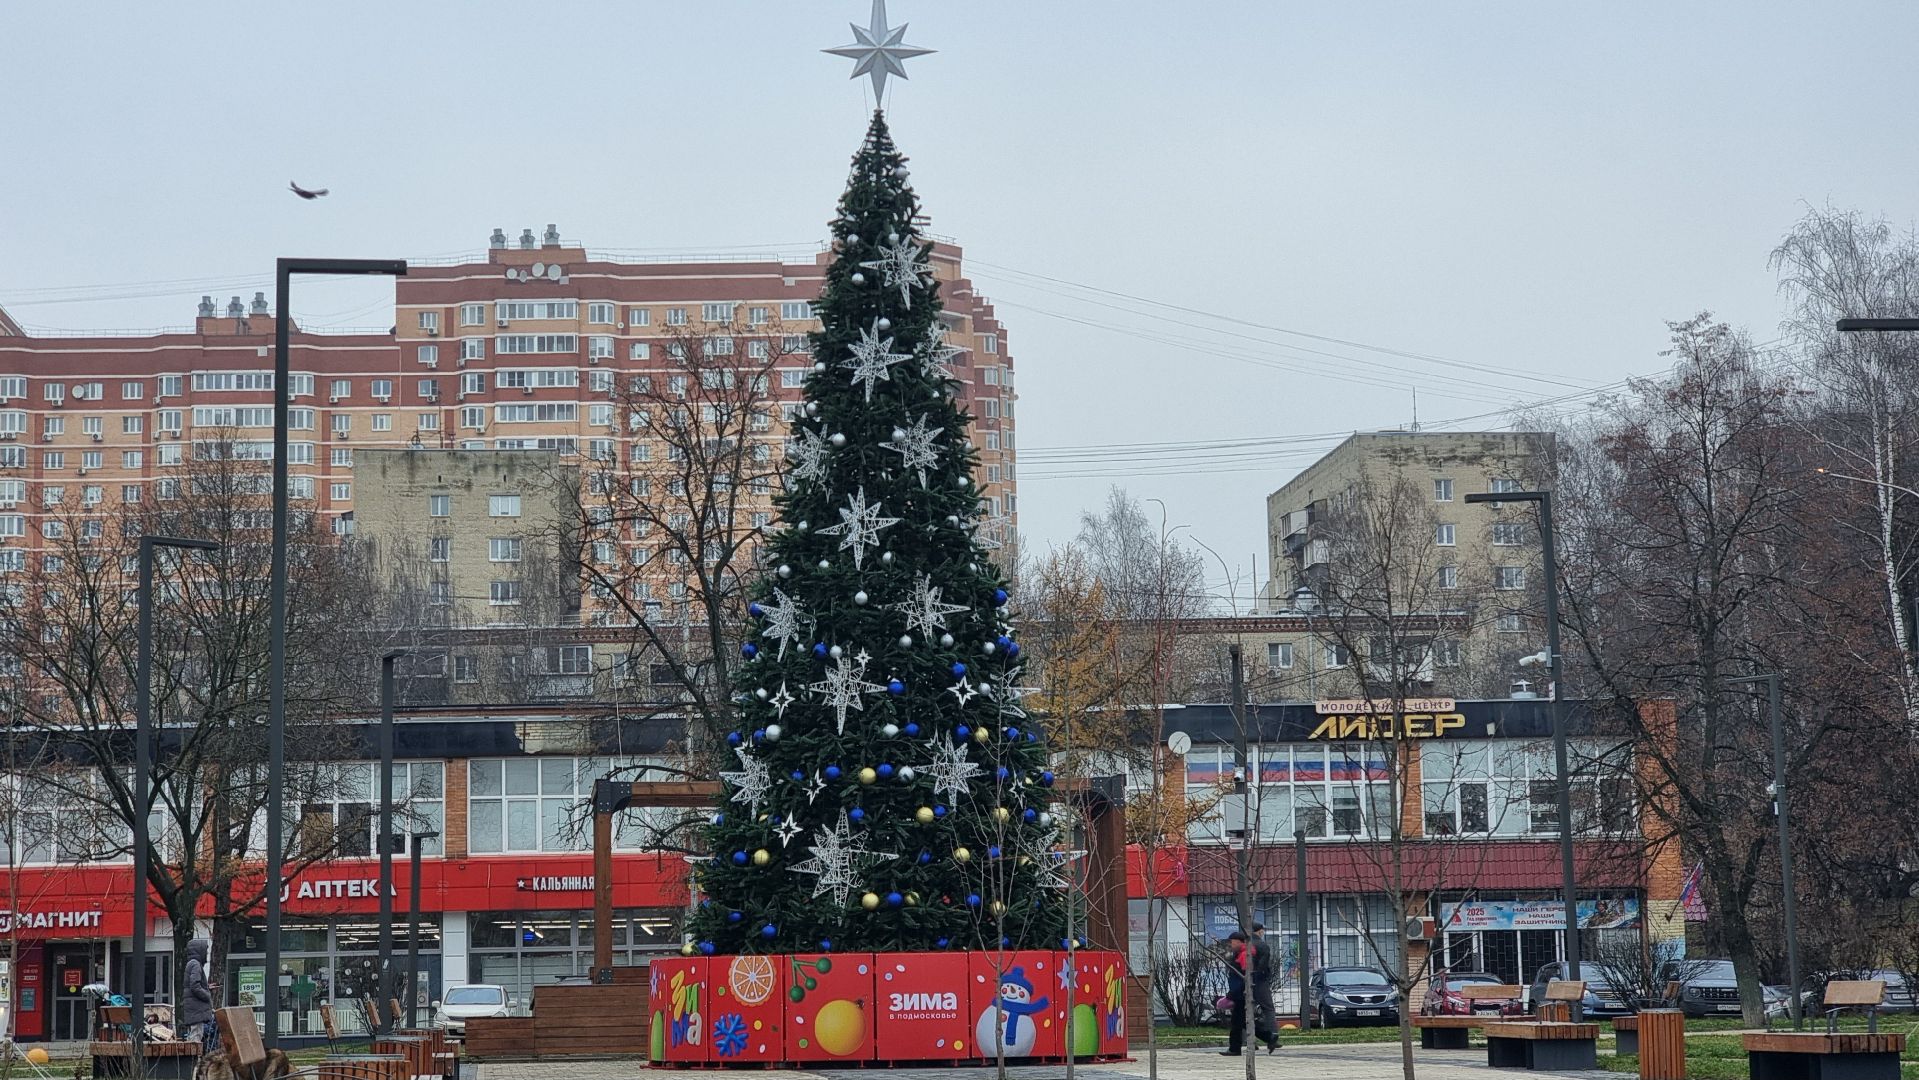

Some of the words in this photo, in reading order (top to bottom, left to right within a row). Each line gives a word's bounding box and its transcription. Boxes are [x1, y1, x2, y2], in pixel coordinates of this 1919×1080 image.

[1415, 701, 1451, 711] ЦЕНТР
[1308, 713, 1466, 741] ЛИДЕР
[532, 876, 595, 891] КАЛЬЯННАЯ
[1466, 907, 1485, 916] 2025
[16, 911, 103, 929] МАГНИТ
